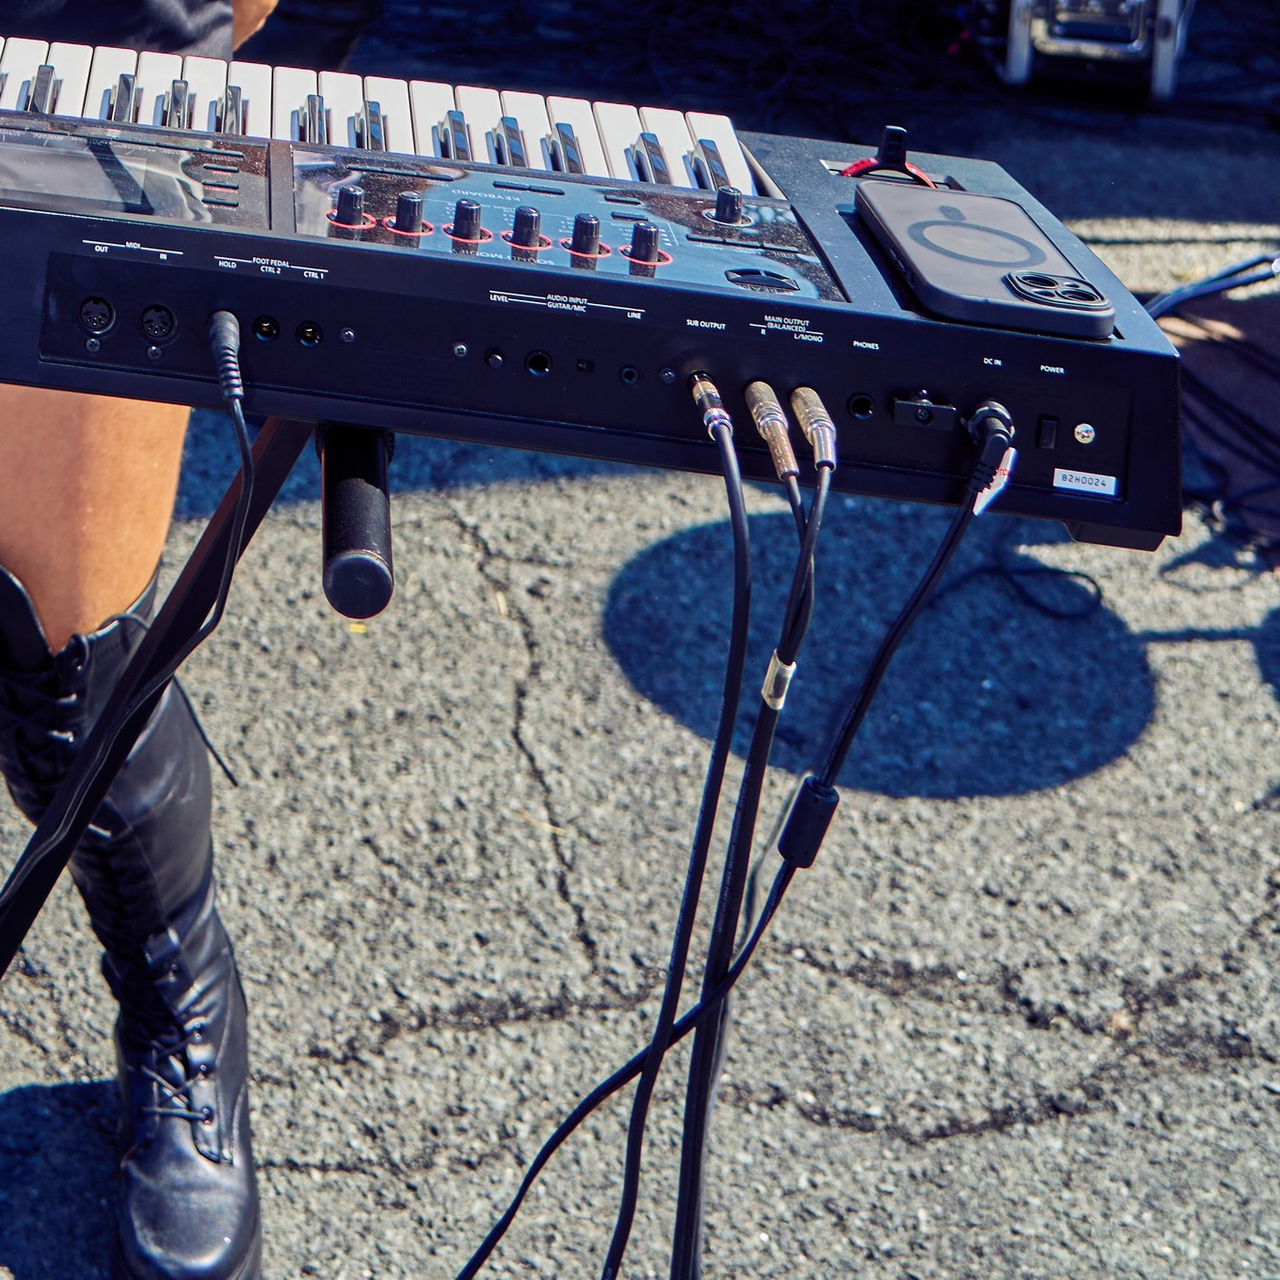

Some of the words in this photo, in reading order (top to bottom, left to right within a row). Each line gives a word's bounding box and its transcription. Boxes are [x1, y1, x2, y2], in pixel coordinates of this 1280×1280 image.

[94, 245, 109, 253] OUT
[125, 241, 140, 249] MIDI
[218, 260, 237, 269] HOLD
[252, 257, 269, 265] FOOT
[270, 259, 290, 268] PEDAL
[260, 265, 276, 274] CTRL
[303, 271, 319, 279] CTRL
[489, 294, 509, 303] LEVEL
[546, 294, 568, 303] AUDIO
[568, 297, 588, 305] INPUT
[547, 301, 587, 313] GUITAR/MIC
[626, 312, 642, 320] LINE
[764, 314, 782, 323] MAIN
[782, 317, 810, 327] OUTPUT
[686, 319, 699, 327] SUB
[699, 320, 726, 330] OUTPUT
[766, 322, 806, 333] (BALANCED)
[760, 328, 766, 336] R
[793, 332, 824, 343] L/MONO
[853, 340, 880, 351] PHONES
[983, 357, 993, 366] DC
[993, 359, 1003, 367] IN
[1040, 364, 1066, 375] POWER
